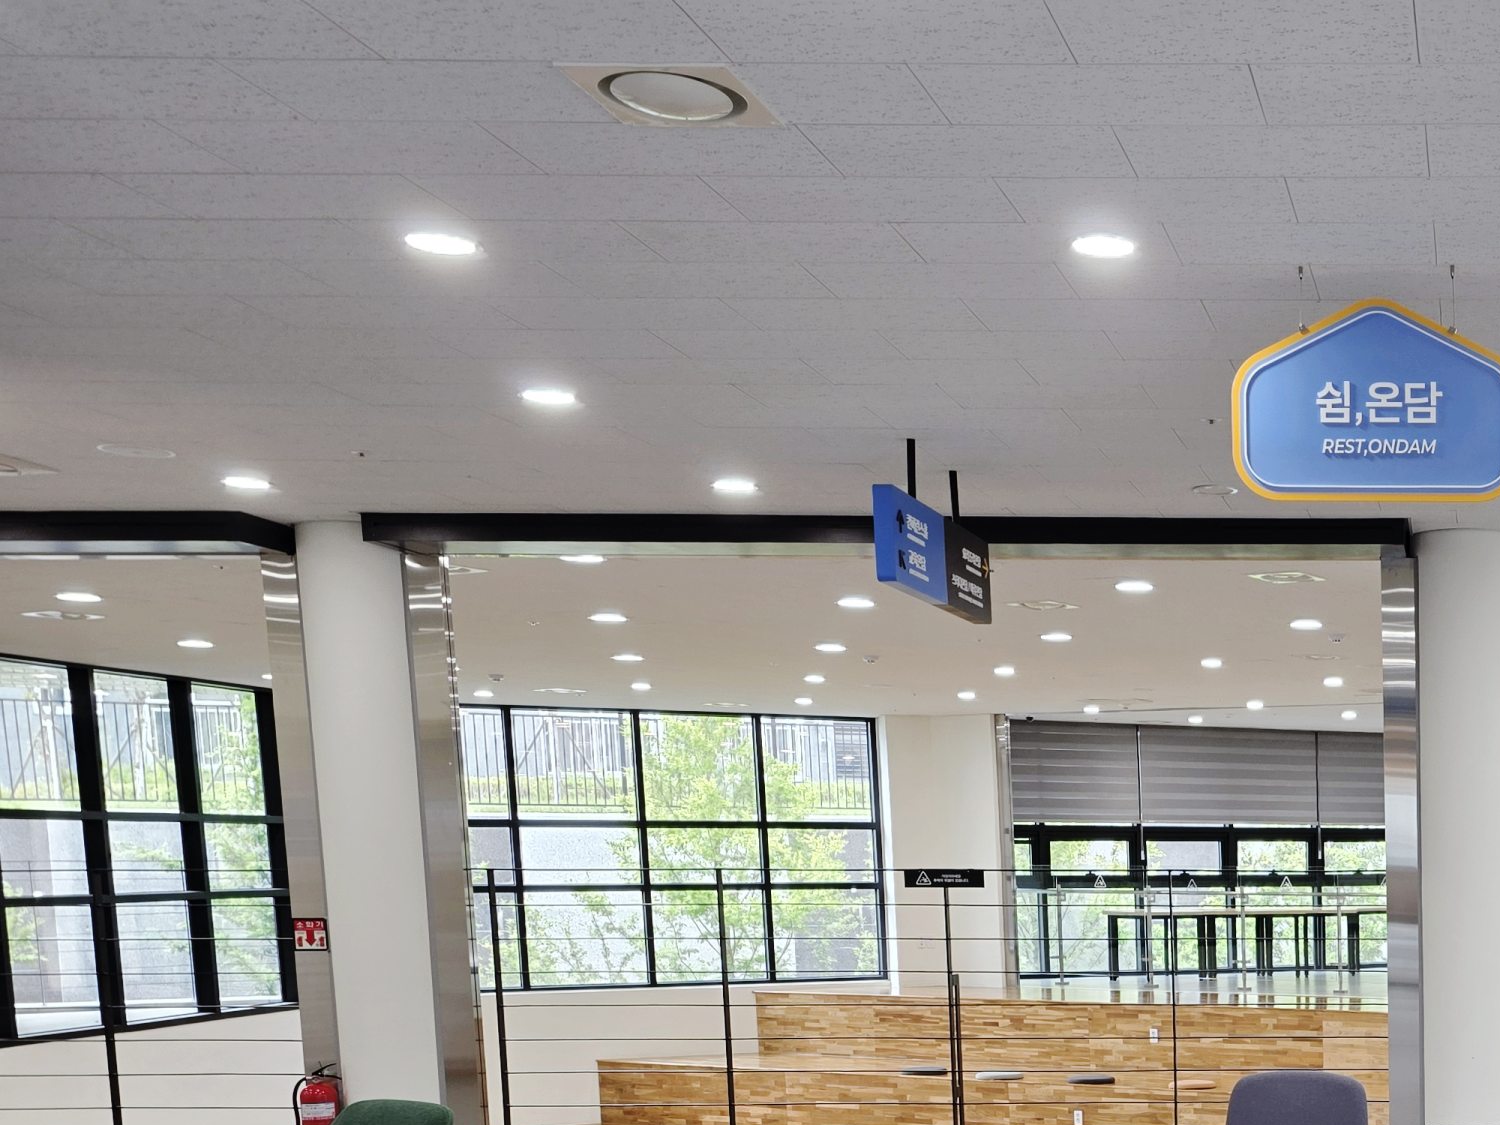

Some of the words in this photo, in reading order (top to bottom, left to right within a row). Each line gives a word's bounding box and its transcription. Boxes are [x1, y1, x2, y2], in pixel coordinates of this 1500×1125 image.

[1315, 380, 1444, 426] 쉼,온담
[1321, 437, 1437, 457] REST,ONDAM
[296, 920, 325, 929] 소화기
